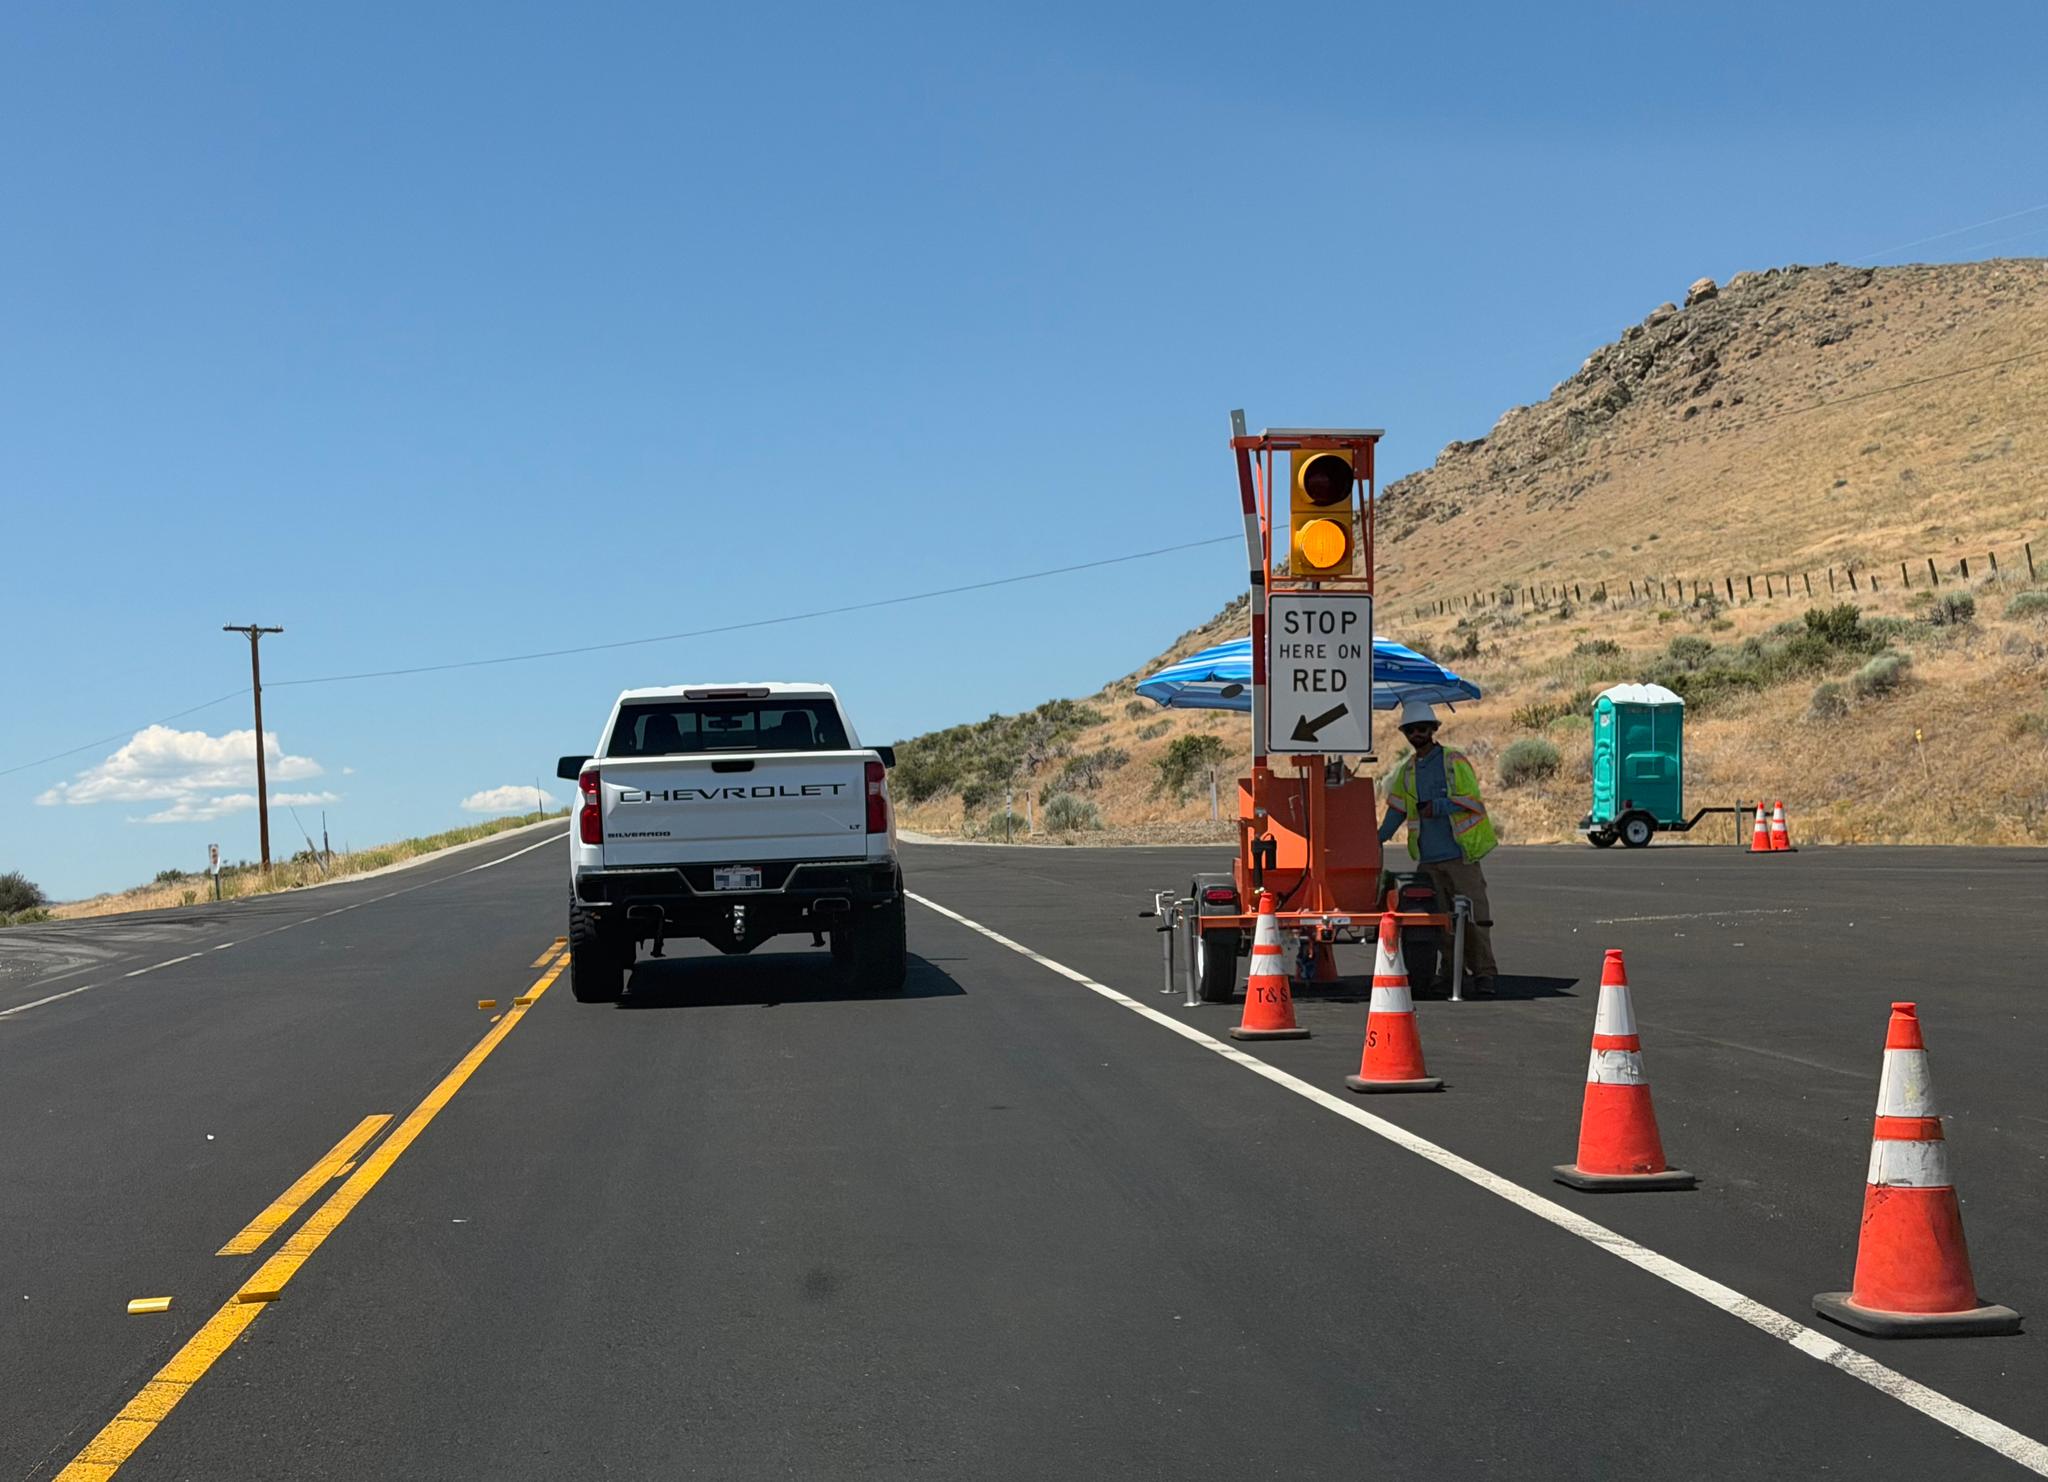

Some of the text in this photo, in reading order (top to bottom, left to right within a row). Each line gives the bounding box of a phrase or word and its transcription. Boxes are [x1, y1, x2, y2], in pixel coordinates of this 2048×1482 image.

[1284, 610, 1357, 634] STOP
[1280, 644, 1361, 659] HERE ON
[1293, 668, 1347, 692] RED
[620, 783, 847, 802] CHEVROLET
[607, 831, 671, 839] SILVERADO
